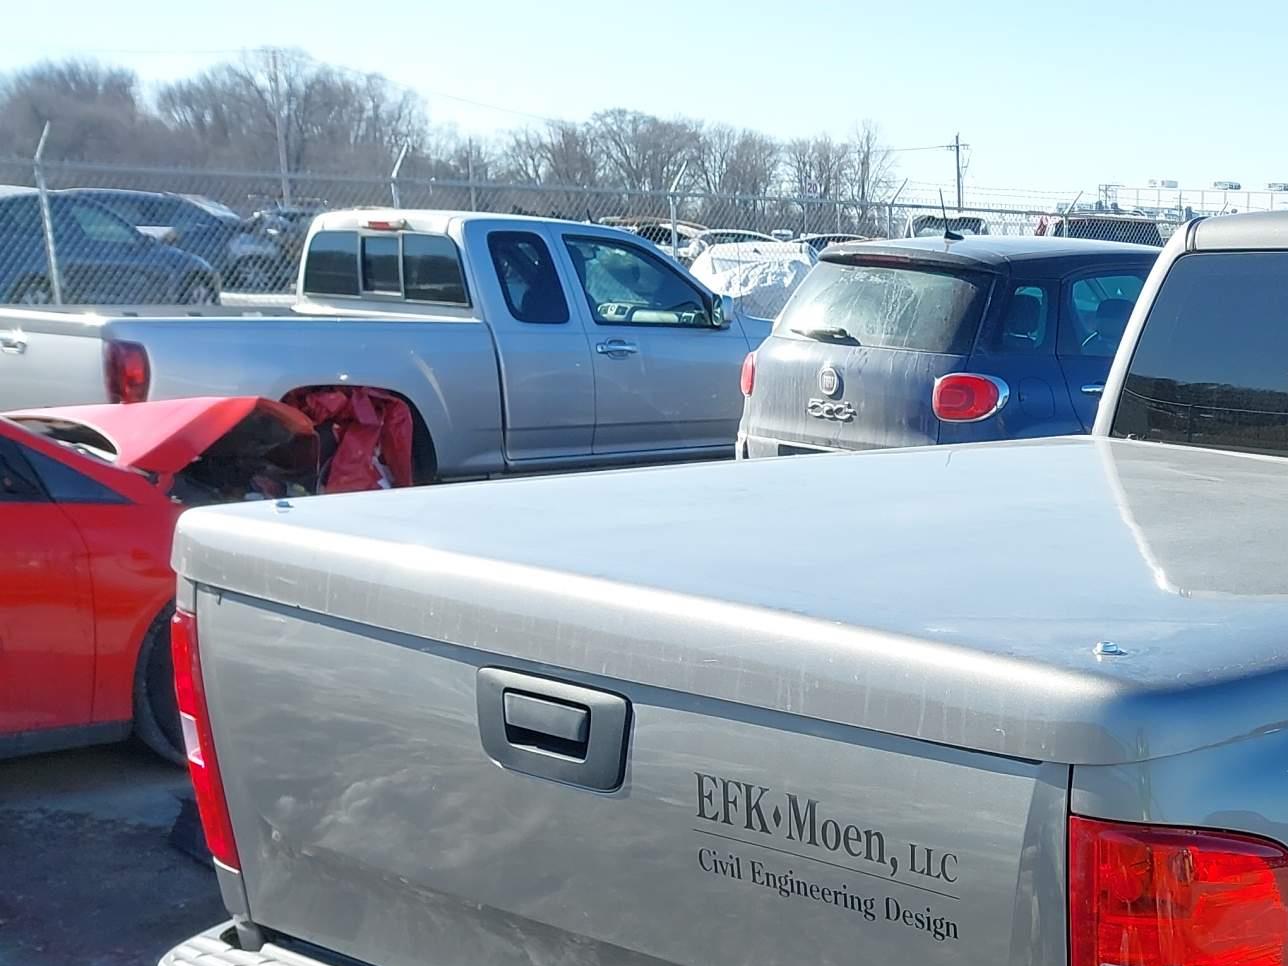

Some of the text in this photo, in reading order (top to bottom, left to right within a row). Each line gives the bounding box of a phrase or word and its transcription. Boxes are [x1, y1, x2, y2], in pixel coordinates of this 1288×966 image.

[698, 848, 959, 941] Civil Engineering Design
[908, 843, 959, 883] LLC
